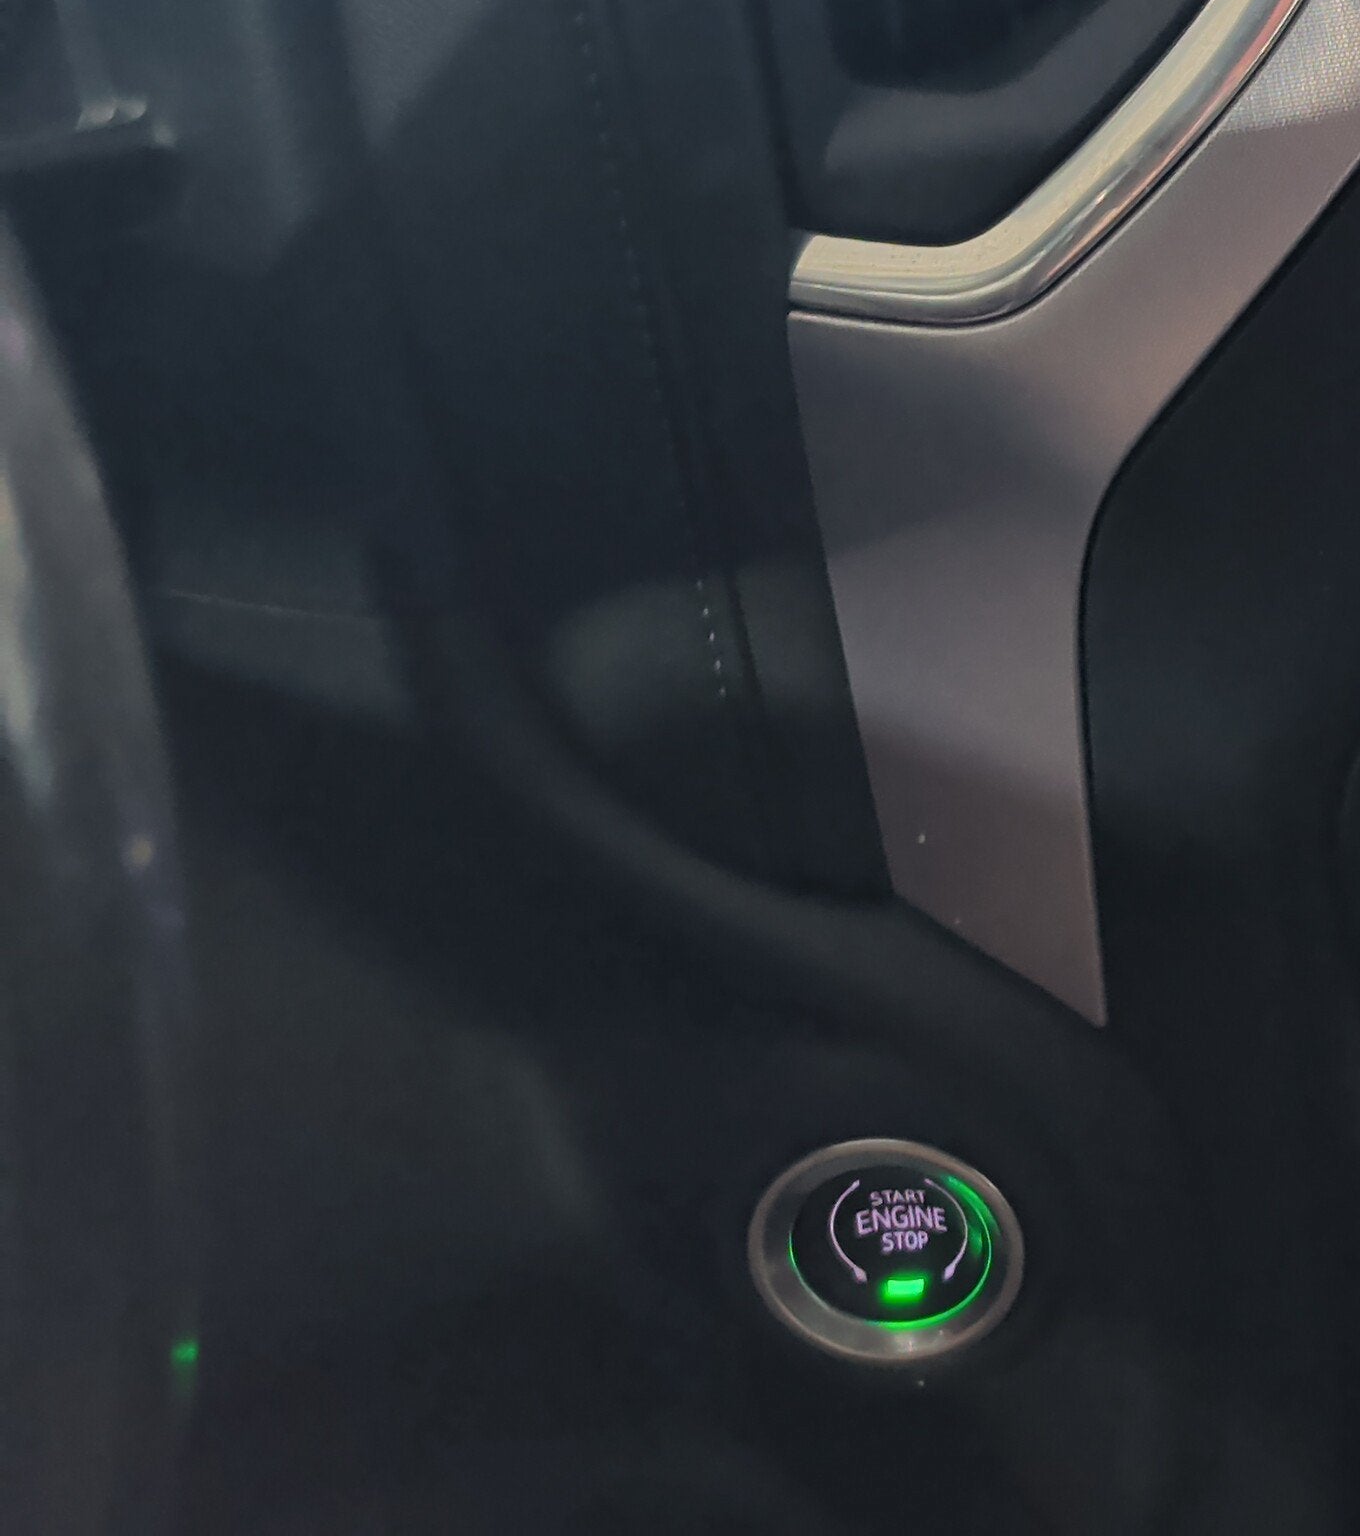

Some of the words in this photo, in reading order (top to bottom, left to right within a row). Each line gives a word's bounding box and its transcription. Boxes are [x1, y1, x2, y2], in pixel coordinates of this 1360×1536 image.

[870, 1189, 925, 1207] START
[855, 1205, 948, 1237] ENGINE
[881, 1231, 928, 1254] STOP
